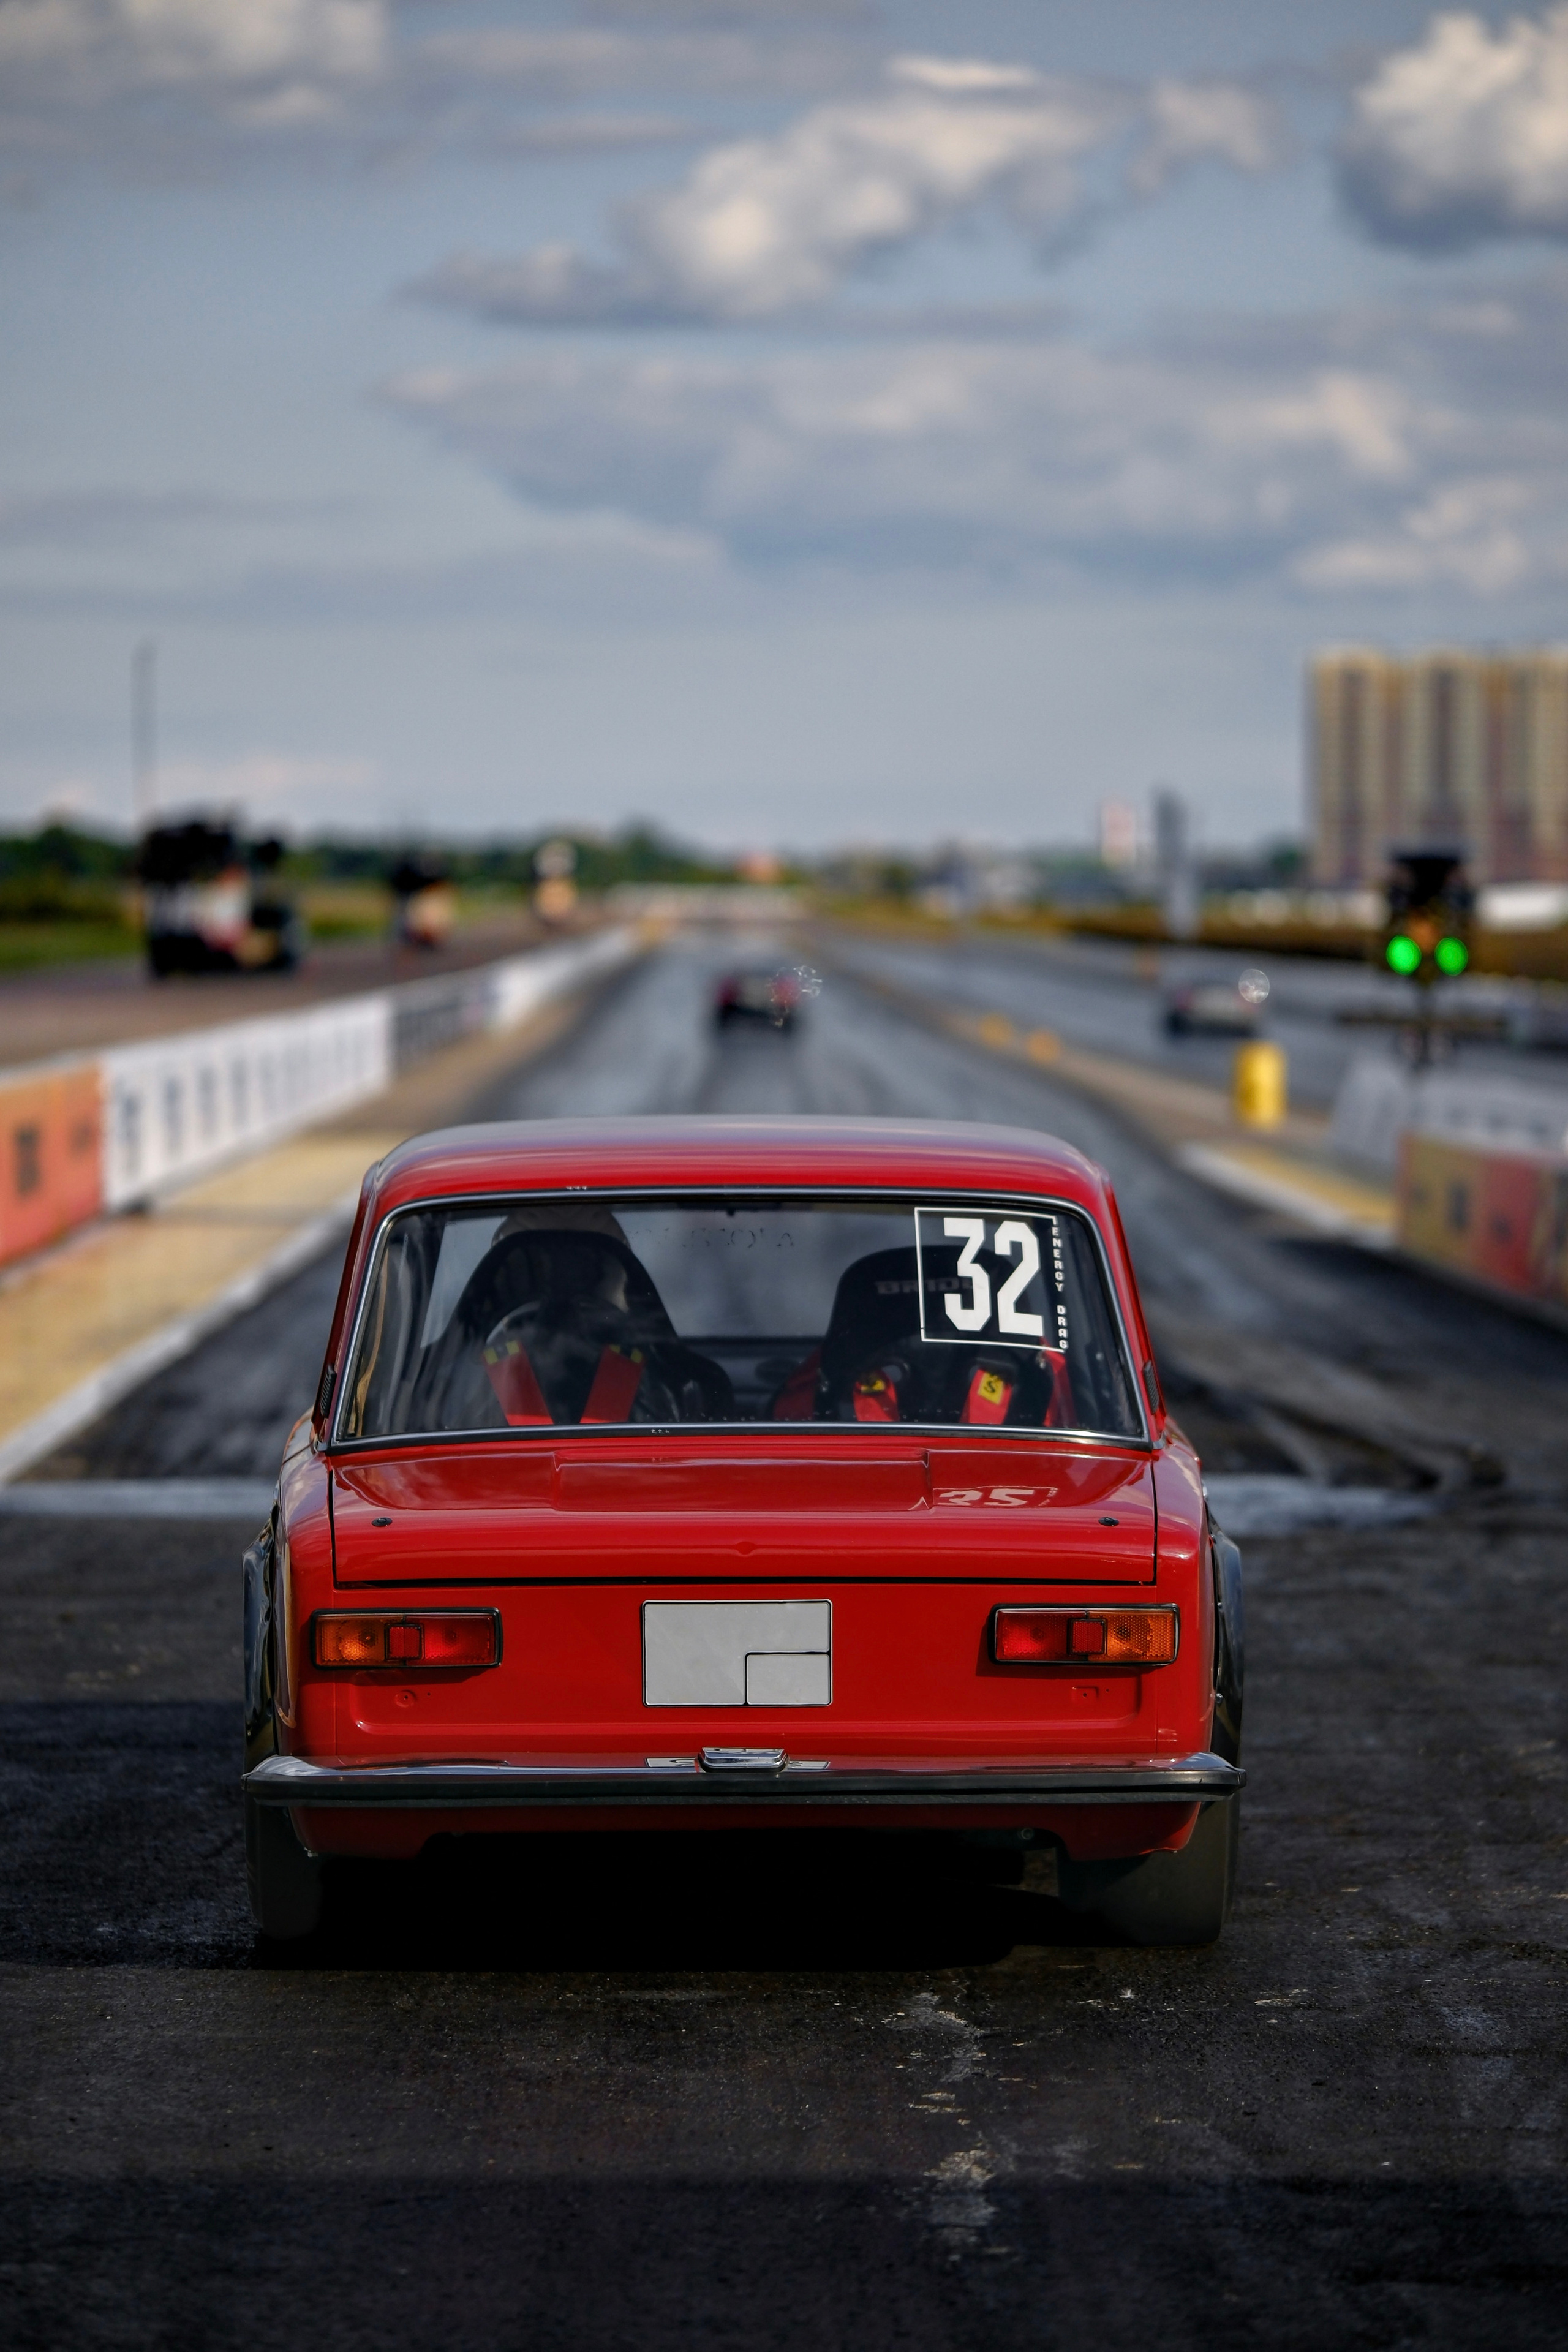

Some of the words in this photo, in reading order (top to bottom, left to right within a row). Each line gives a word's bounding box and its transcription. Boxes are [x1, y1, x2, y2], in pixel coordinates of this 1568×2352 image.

[943, 1216, 1044, 1336] 32
[1052, 1227, 1064, 1292] ENERGY
[1057, 1305, 1069, 1349] DRAG
